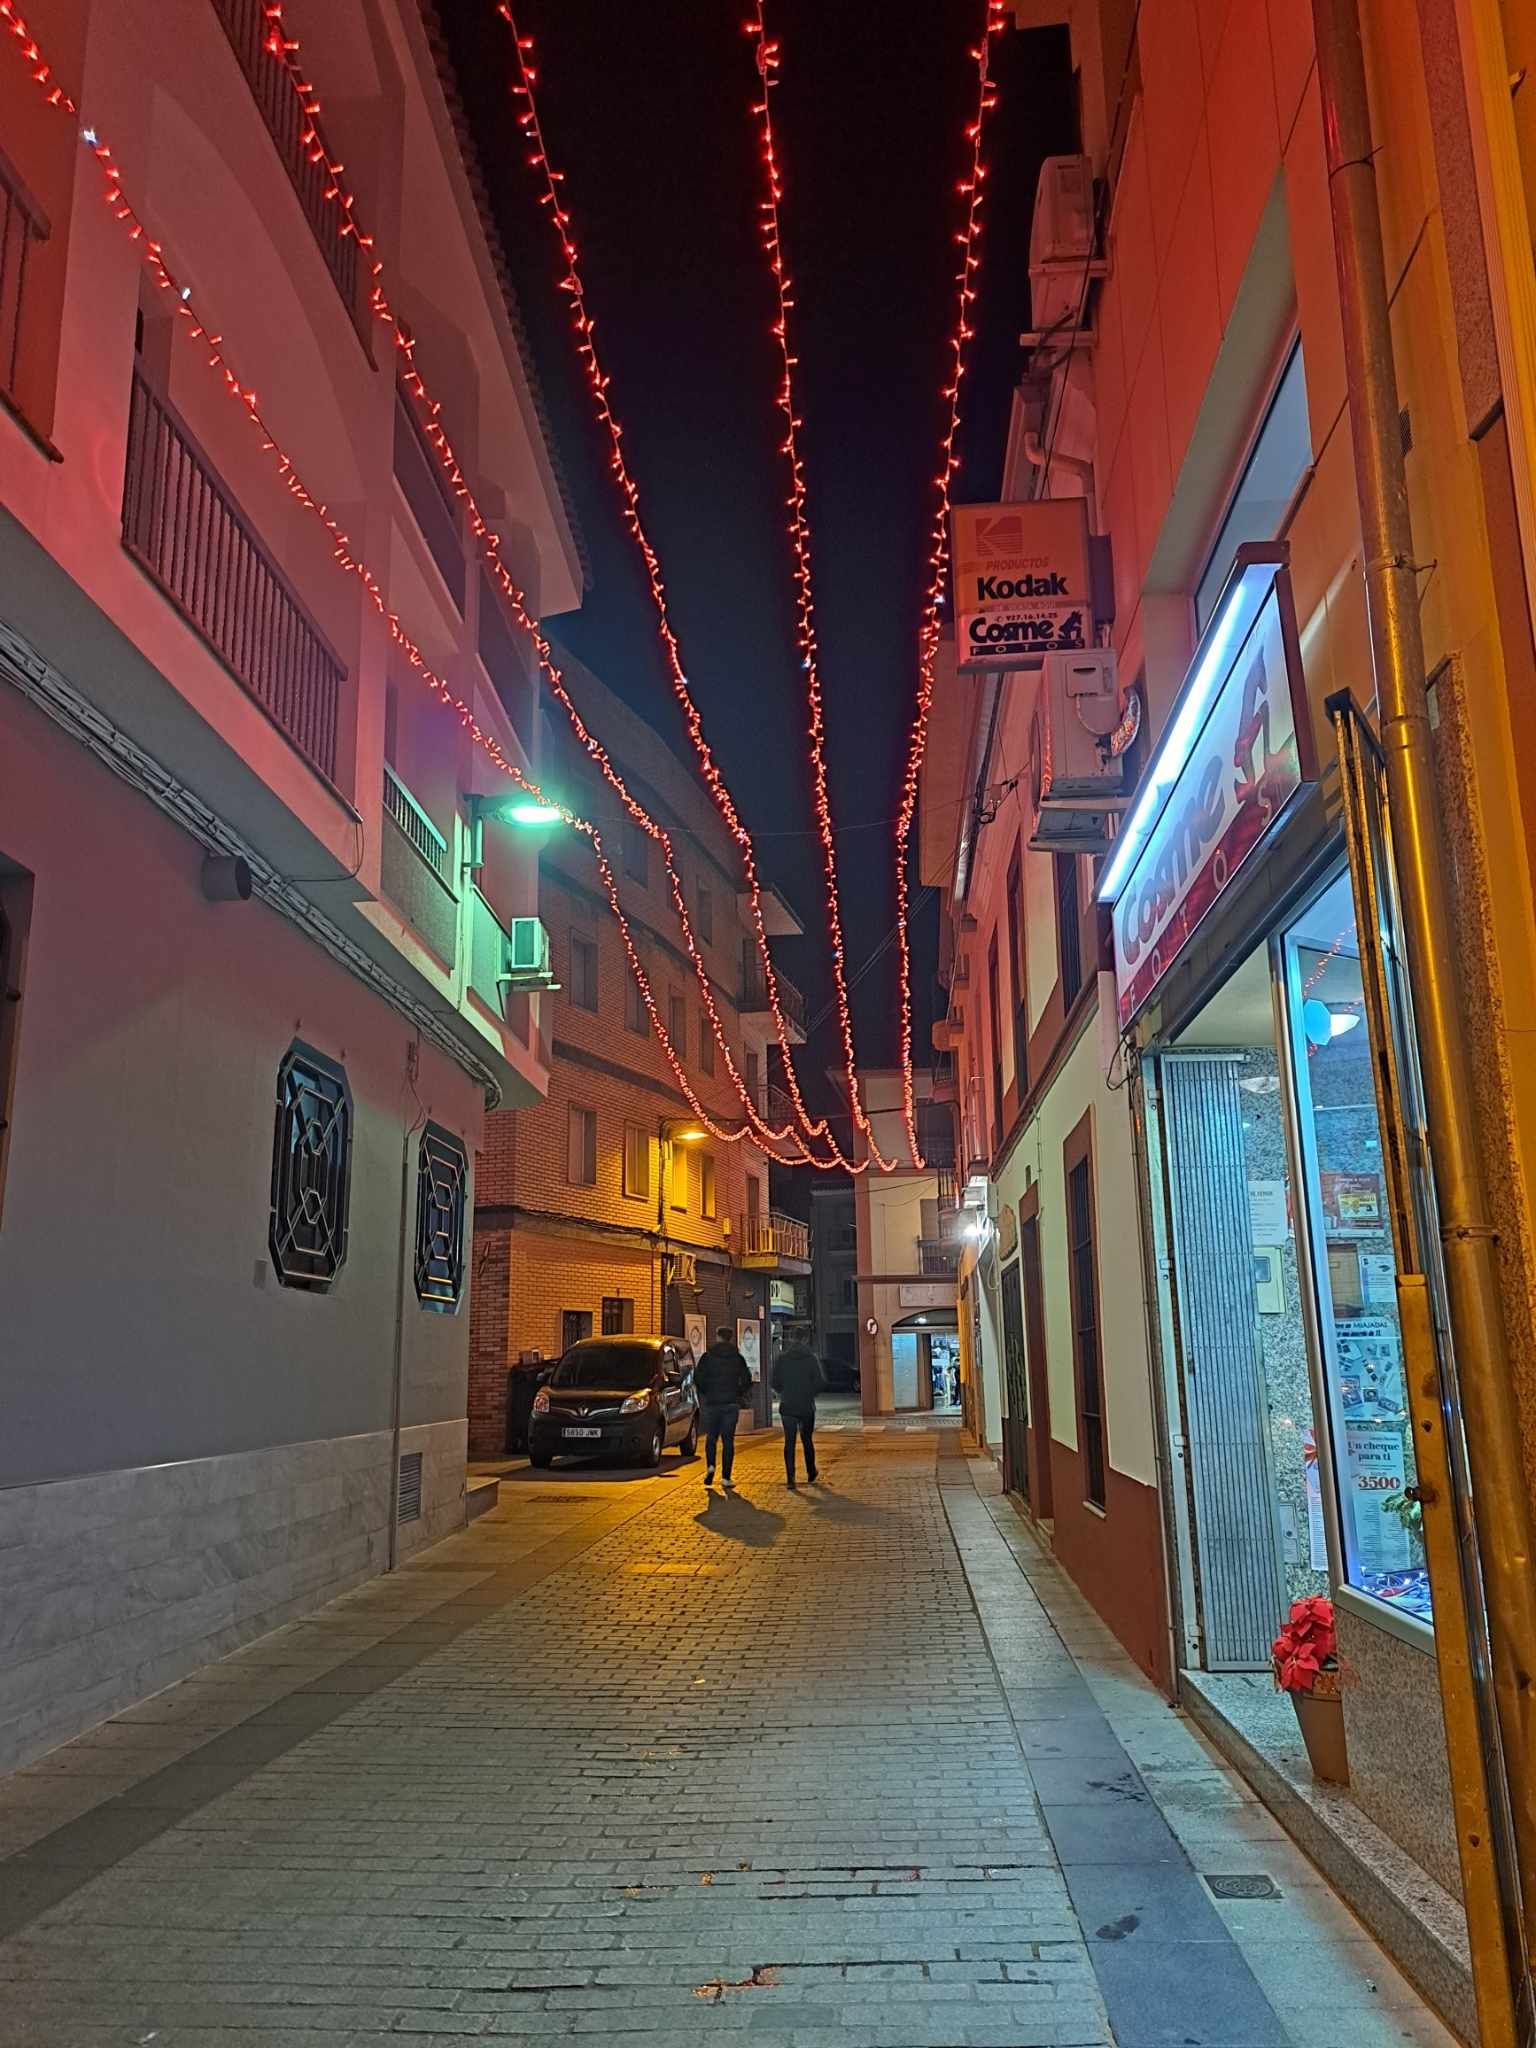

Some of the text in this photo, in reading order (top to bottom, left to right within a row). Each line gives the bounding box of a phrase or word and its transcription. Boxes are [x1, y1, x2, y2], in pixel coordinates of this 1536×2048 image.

[986, 557, 1049, 570] PRODUCTOS
[977, 572, 1069, 600] Kodak
[969, 617, 1054, 644] Cosme
[973, 639, 1082, 655] FOTOS
[1122, 756, 1226, 965] Cosme
[1128, 785, 1273, 1013] FOTOS
[1348, 1441, 1400, 1452] Un cheque
[1358, 1453, 1381, 1462] para
[1358, 1476, 1401, 1489] 3500
